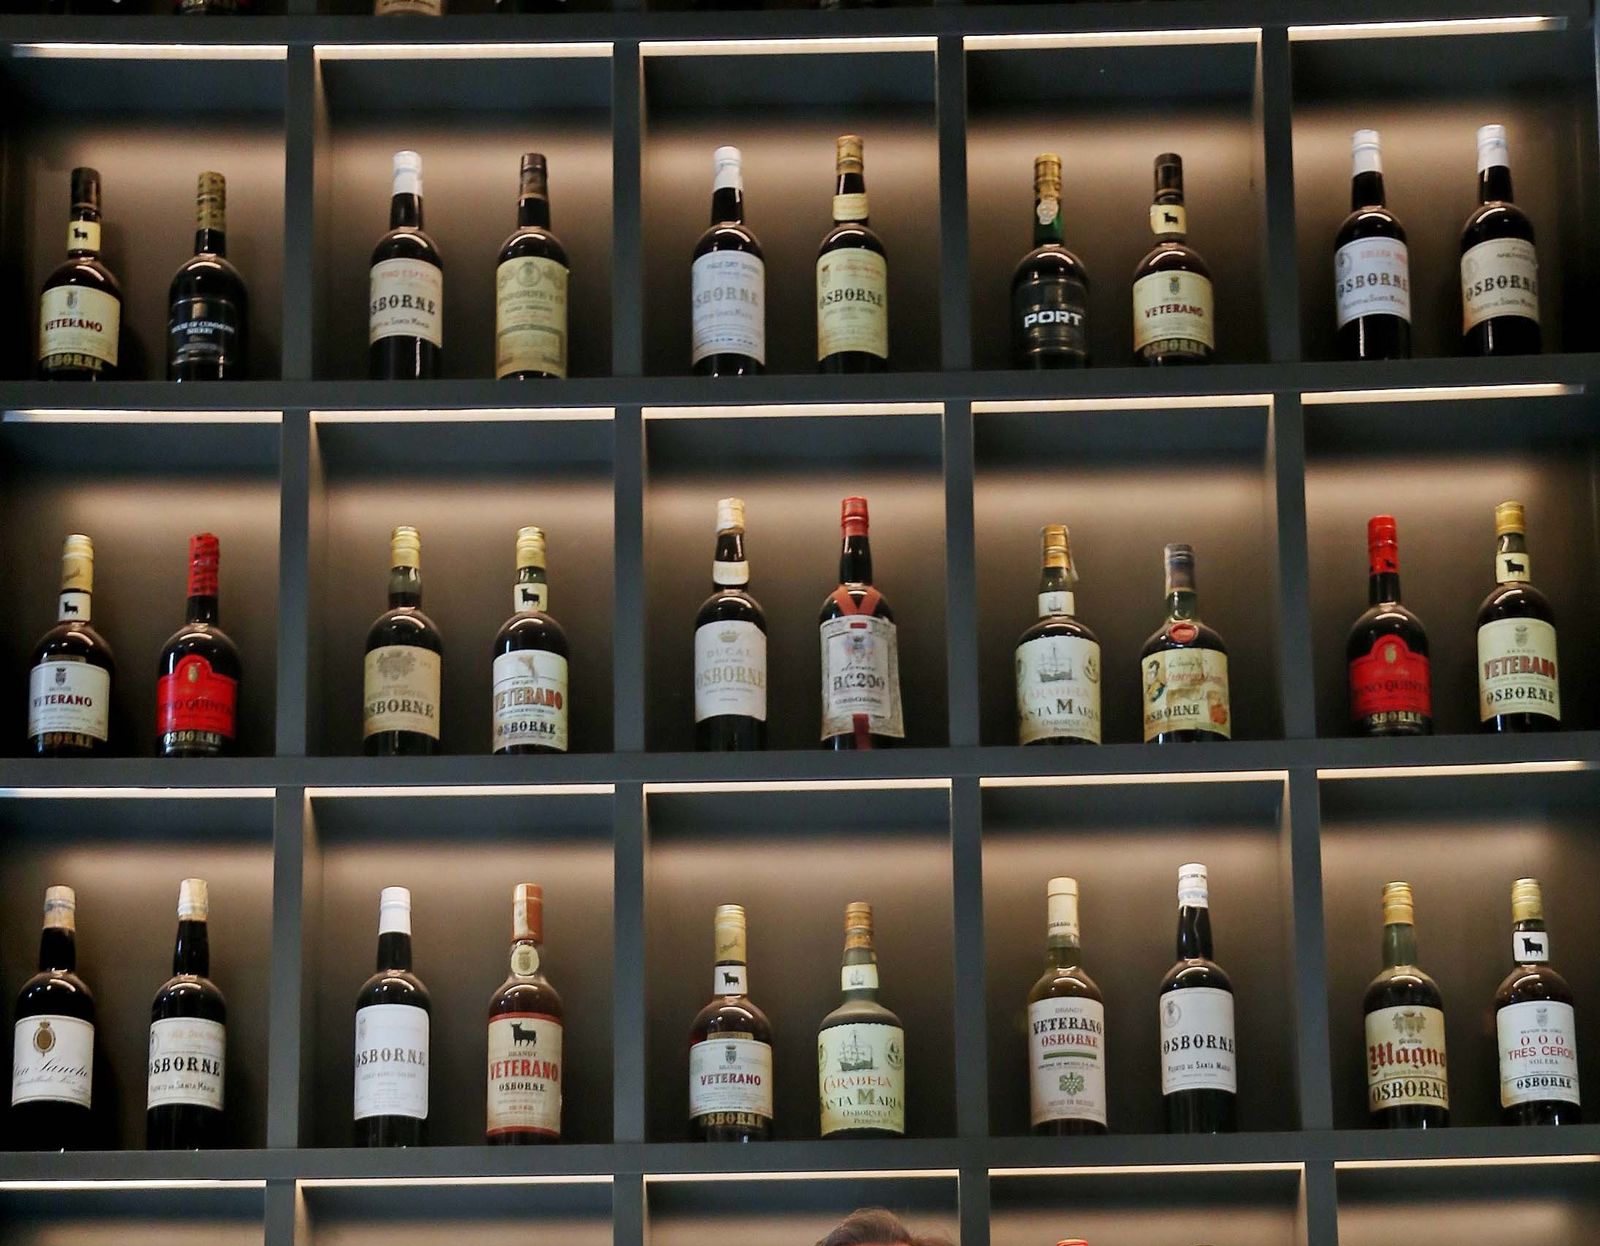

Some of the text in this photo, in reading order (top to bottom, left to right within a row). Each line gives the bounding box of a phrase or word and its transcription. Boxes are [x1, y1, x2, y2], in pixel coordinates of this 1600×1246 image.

[372, 294, 436, 316] SBORNE
[696, 287, 758, 309] SBORNE
[1024, 310, 1084, 328] PORT
[1145, 304, 1205, 318] VETERANO
[45, 318, 104, 332] VETERANO
[1484, 655, 1557, 681] VETERANO
[696, 666, 767, 691] OSBORNE
[493, 687, 564, 712] VETERANO
[1486, 687, 1556, 705] OSBORNE
[366, 699, 434, 719] OSBORNE
[497, 722, 557, 737] OSBORNE
[1033, 1017, 1103, 1036] VETERANO
[1041, 1034, 1099, 1048] OSBORNE
[1163, 1034, 1235, 1055] OSBORNE
[1508, 1046, 1537, 1061] TRES
[490, 1059, 560, 1081] VETERANO
[700, 1072, 762, 1086] VETERANO
[498, 1081, 546, 1092] OSBORNE
[1516, 1076, 1573, 1089] OSBORNE
